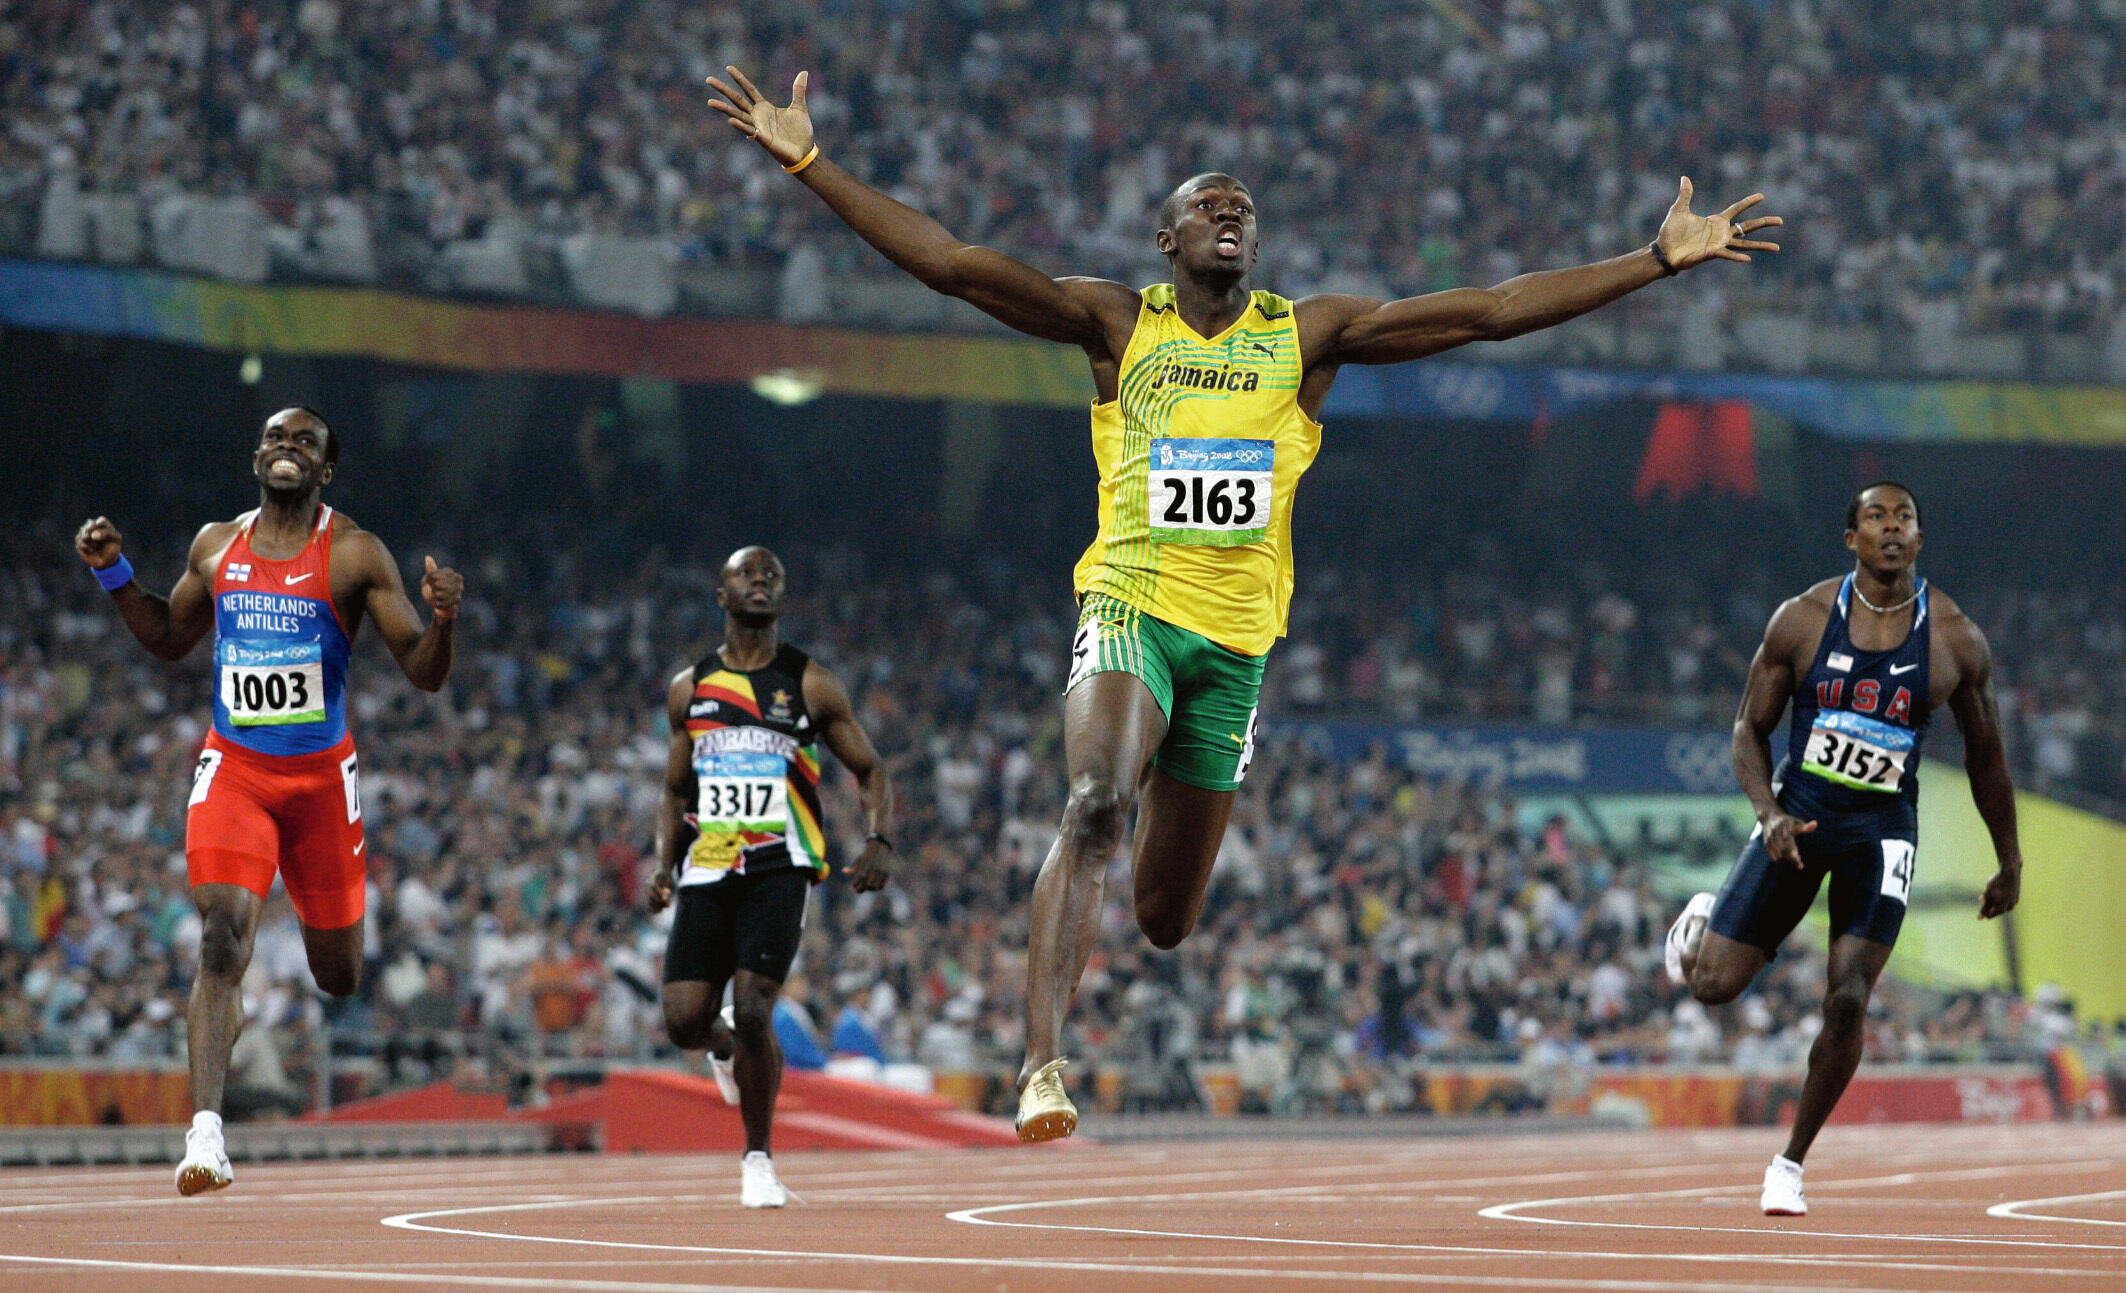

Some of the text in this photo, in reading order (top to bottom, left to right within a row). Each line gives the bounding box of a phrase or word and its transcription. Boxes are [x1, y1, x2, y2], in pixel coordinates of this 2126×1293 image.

[1152, 357, 1260, 392] jamaica
[1175, 450, 1233, 463] Beijing 2008
[1163, 477, 1256, 525] 2163
[222, 593, 317, 619] NETHERLANDS
[236, 613, 300, 633] ANTILLES
[232, 671, 308, 711] 1003
[1816, 678, 1912, 725] USA
[1817, 733, 1893, 784] 3152
[709, 784, 773, 817] 3317
[1891, 849, 1908, 893] 4
